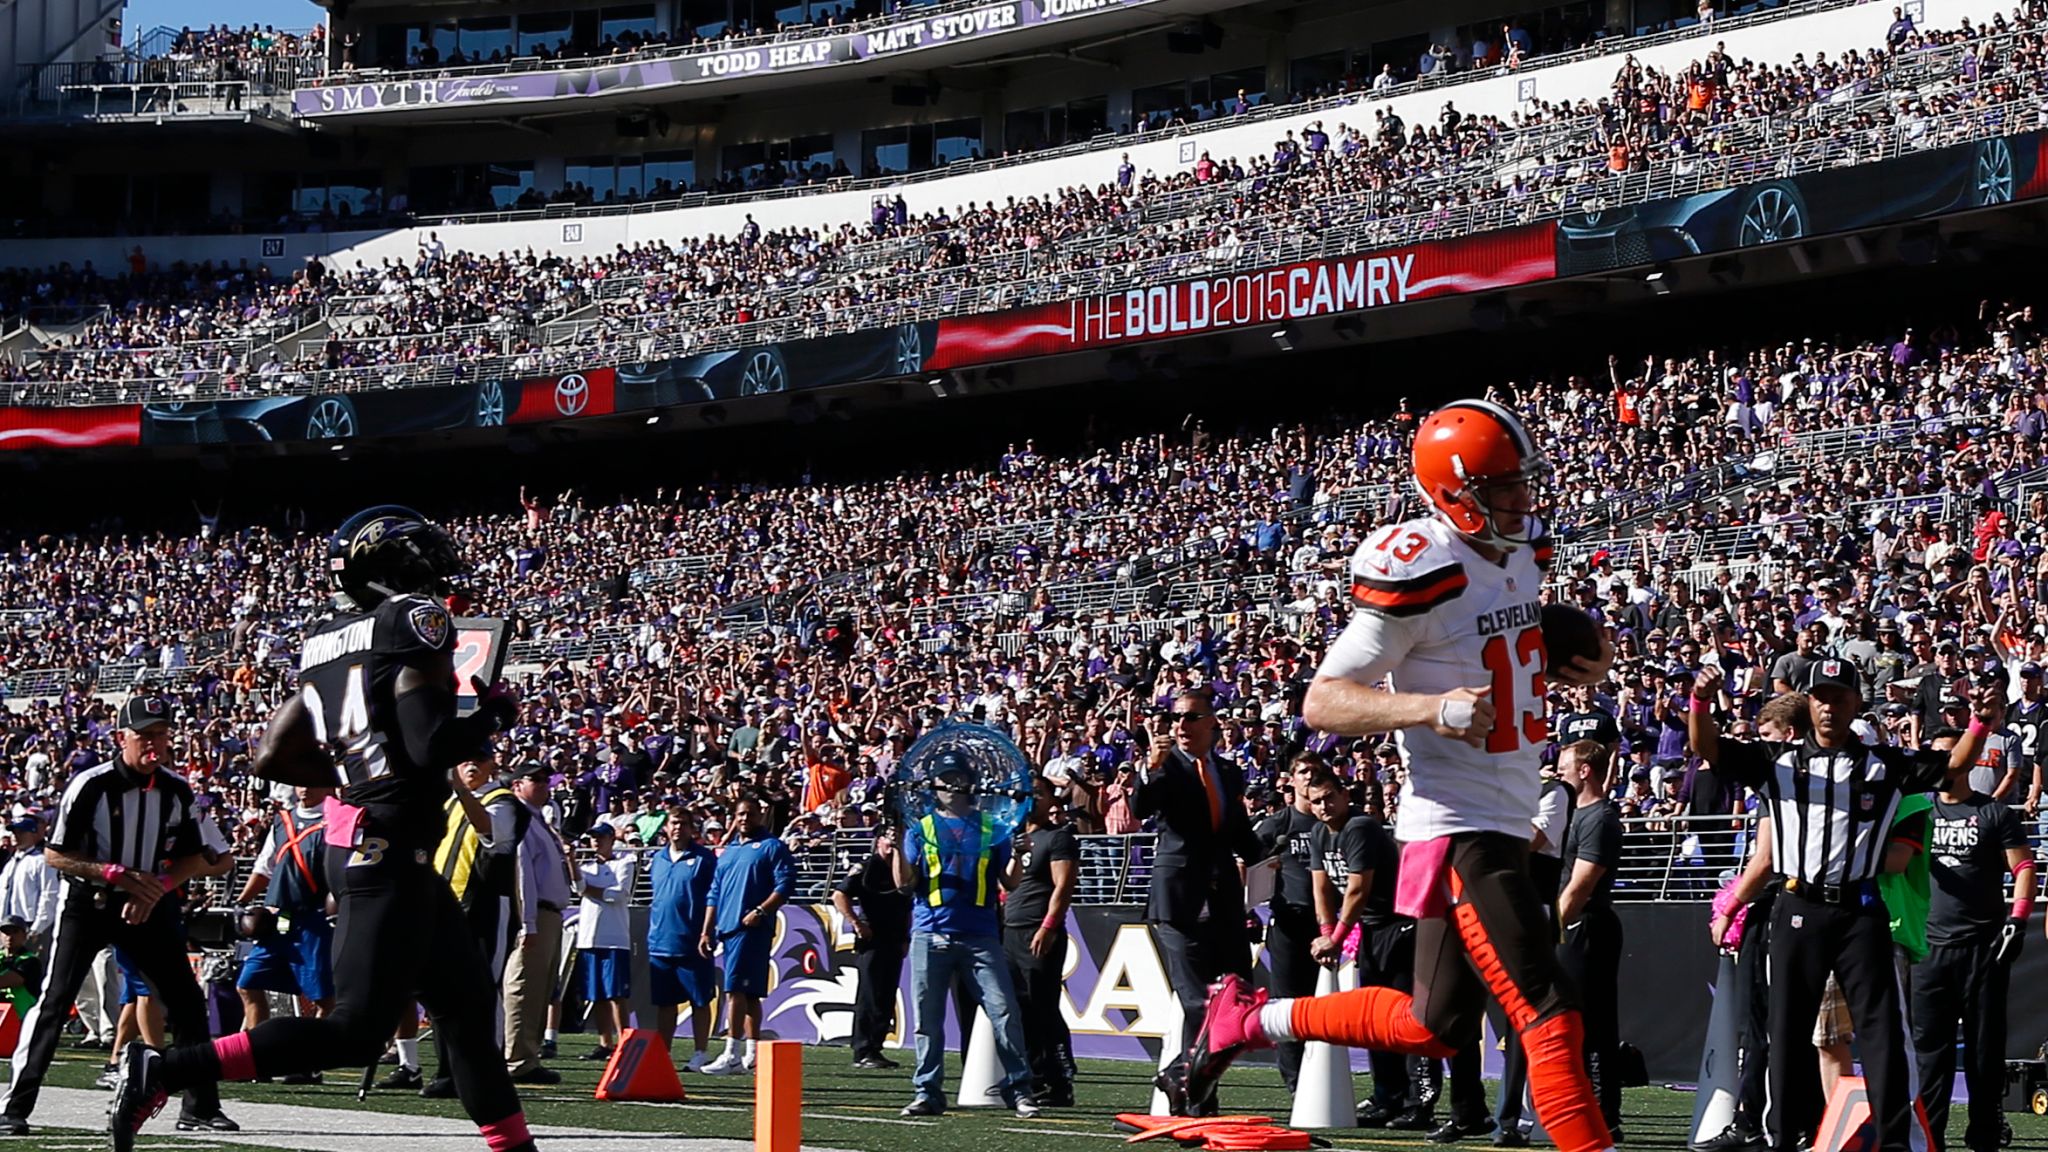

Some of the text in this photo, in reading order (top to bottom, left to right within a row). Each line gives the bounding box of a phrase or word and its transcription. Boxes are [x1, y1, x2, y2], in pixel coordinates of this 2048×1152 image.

[867, 8, 1017, 53] MATT STOVER
[697, 42, 831, 77] TODD HEAP
[321, 82, 439, 112] SMYTH
[1070, 254, 1415, 343] THE BOLD 2015 CAMRY
[1376, 528, 1429, 563] 13
[1477, 600, 1542, 636] CLEVELAN
[1481, 626, 1548, 753] 13
[1933, 827, 1979, 846] AVENS
[1455, 902, 1539, 1033] BROWNS
